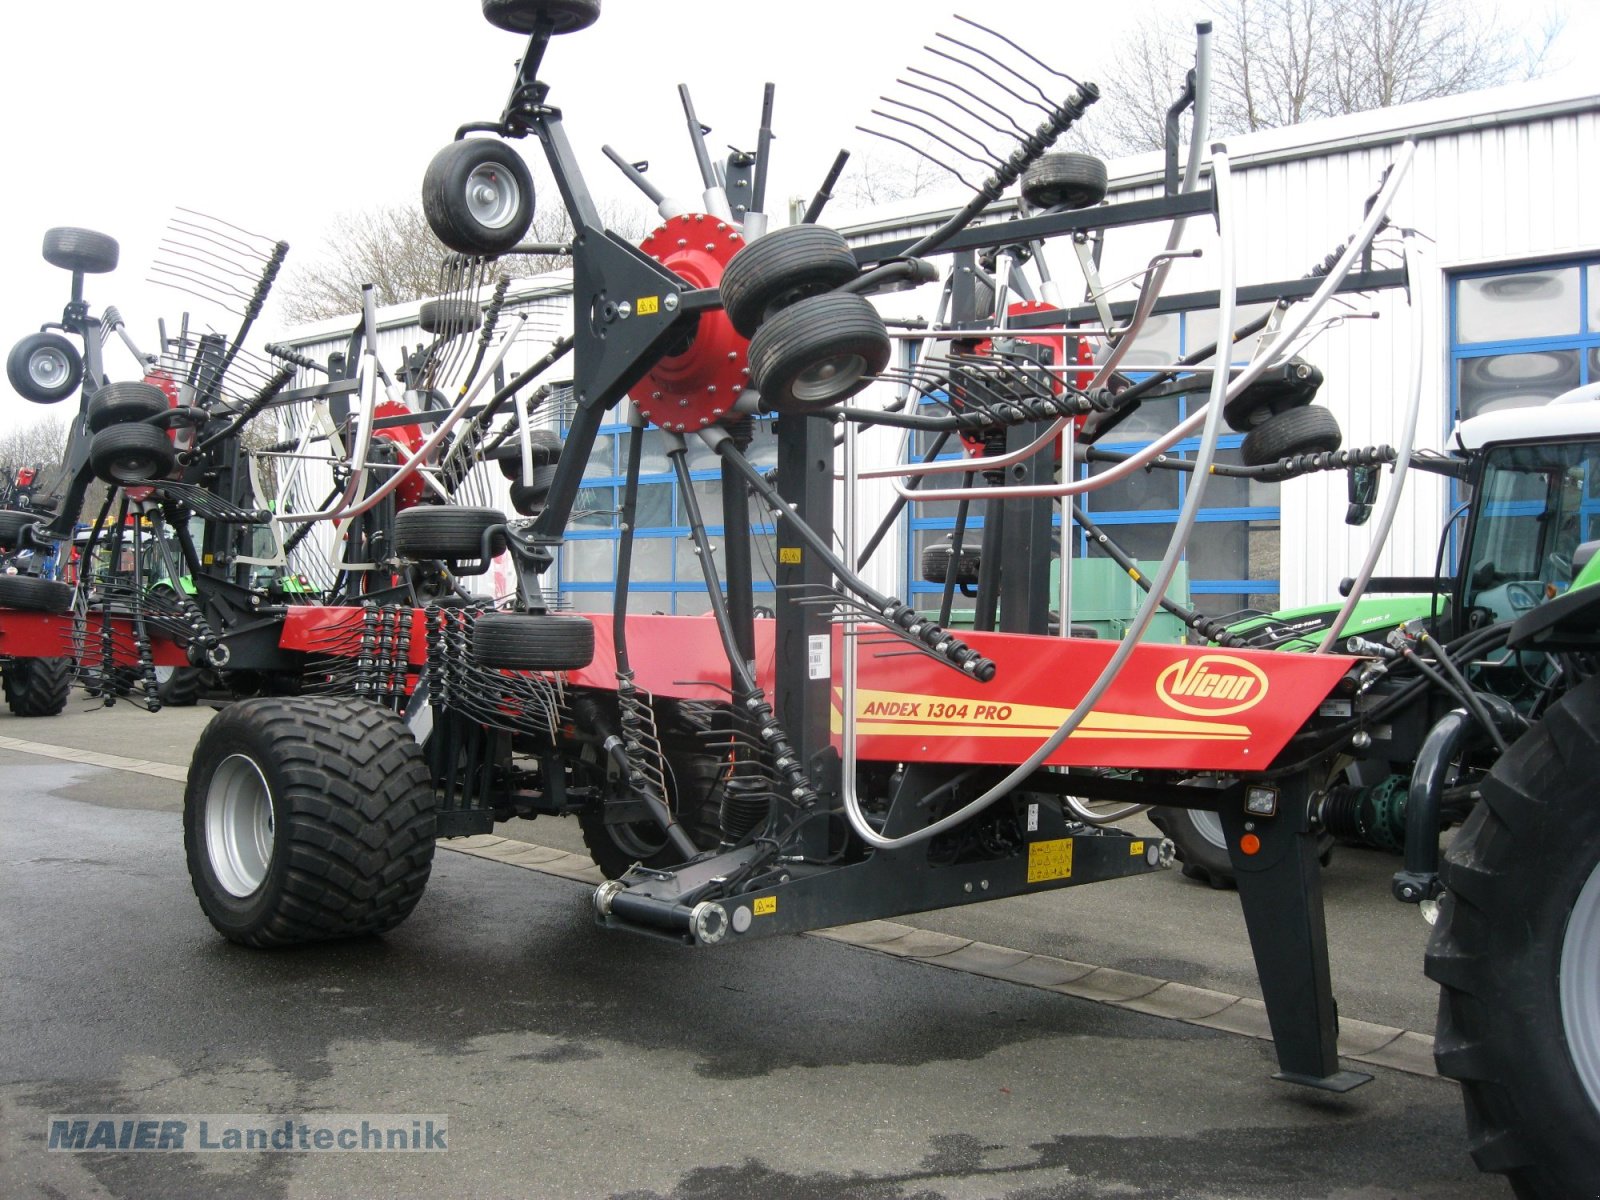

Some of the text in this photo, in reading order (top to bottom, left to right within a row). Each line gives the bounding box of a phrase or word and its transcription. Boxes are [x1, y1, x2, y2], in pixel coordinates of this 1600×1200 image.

[1167, 655, 1258, 702] Vicon
[863, 701, 1012, 721] ANDEX 1304 PRO
